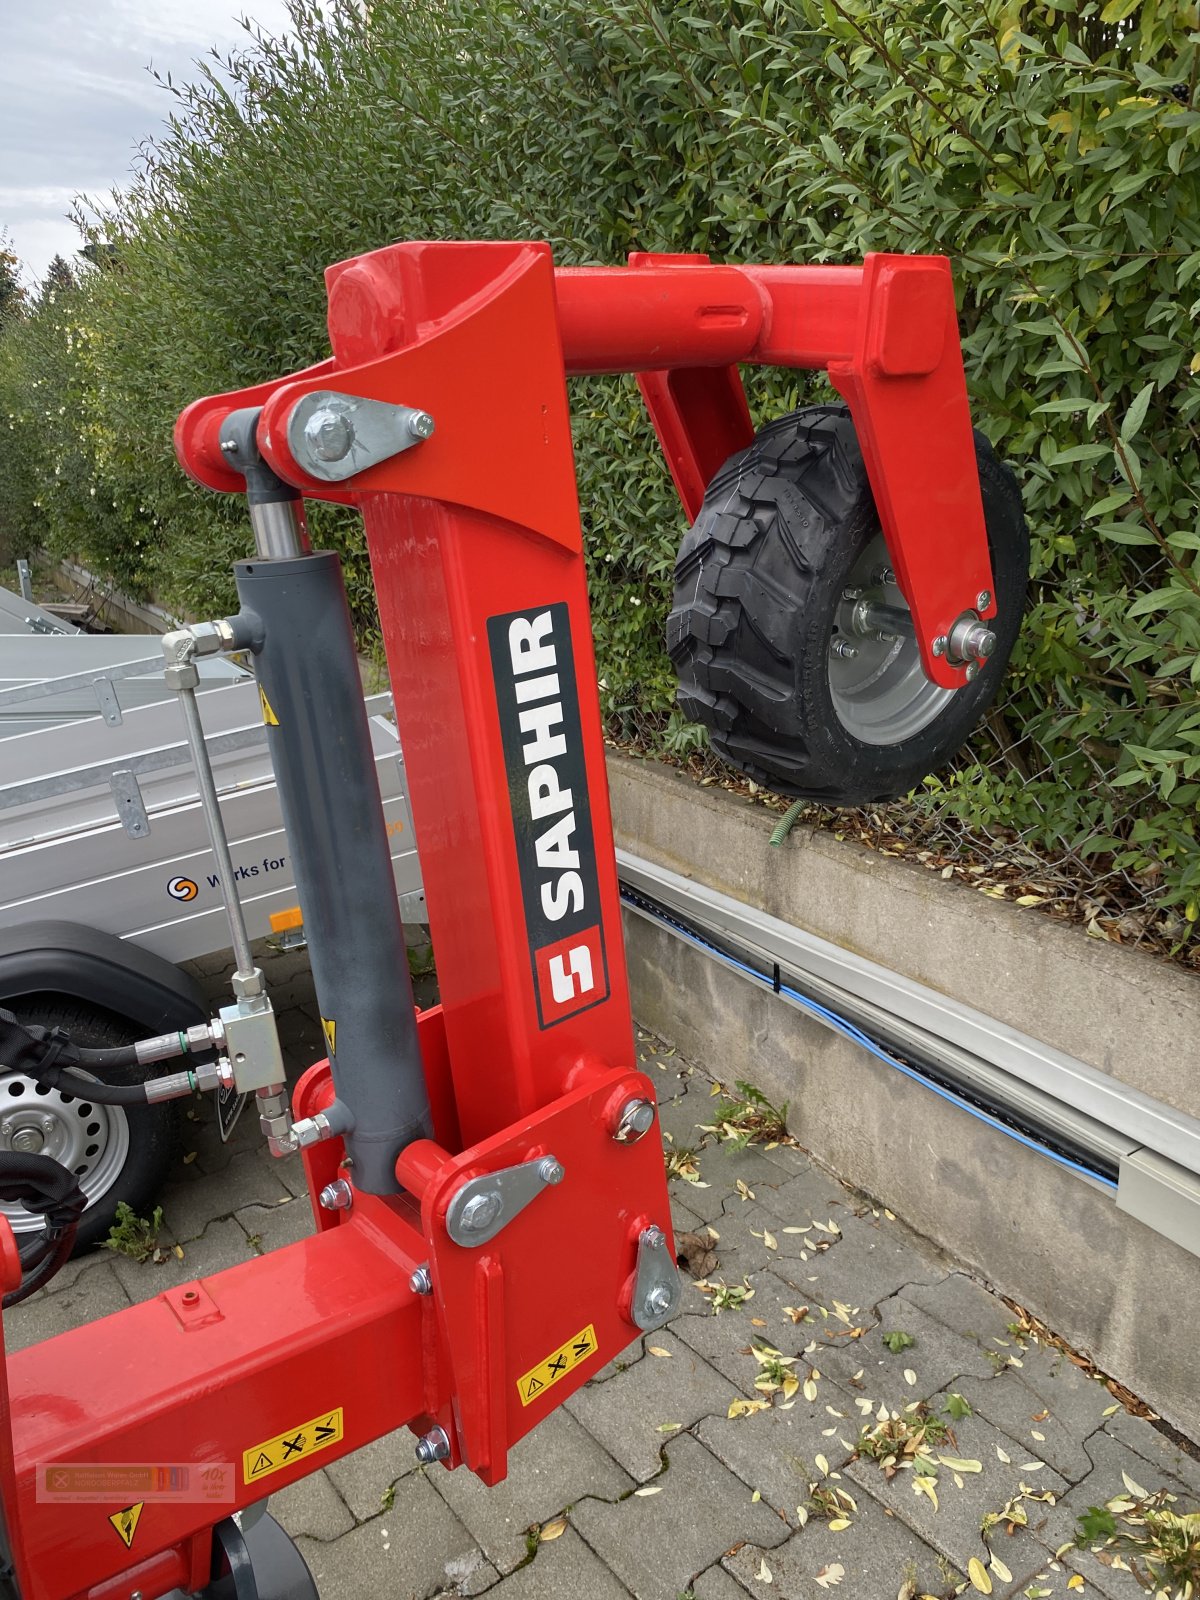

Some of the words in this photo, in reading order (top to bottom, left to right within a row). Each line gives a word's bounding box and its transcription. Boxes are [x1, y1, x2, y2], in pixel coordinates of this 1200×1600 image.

[508, 610, 585, 922] SAPHIR
[206, 865, 259, 888] Wrks
[262, 858, 285, 872] for
